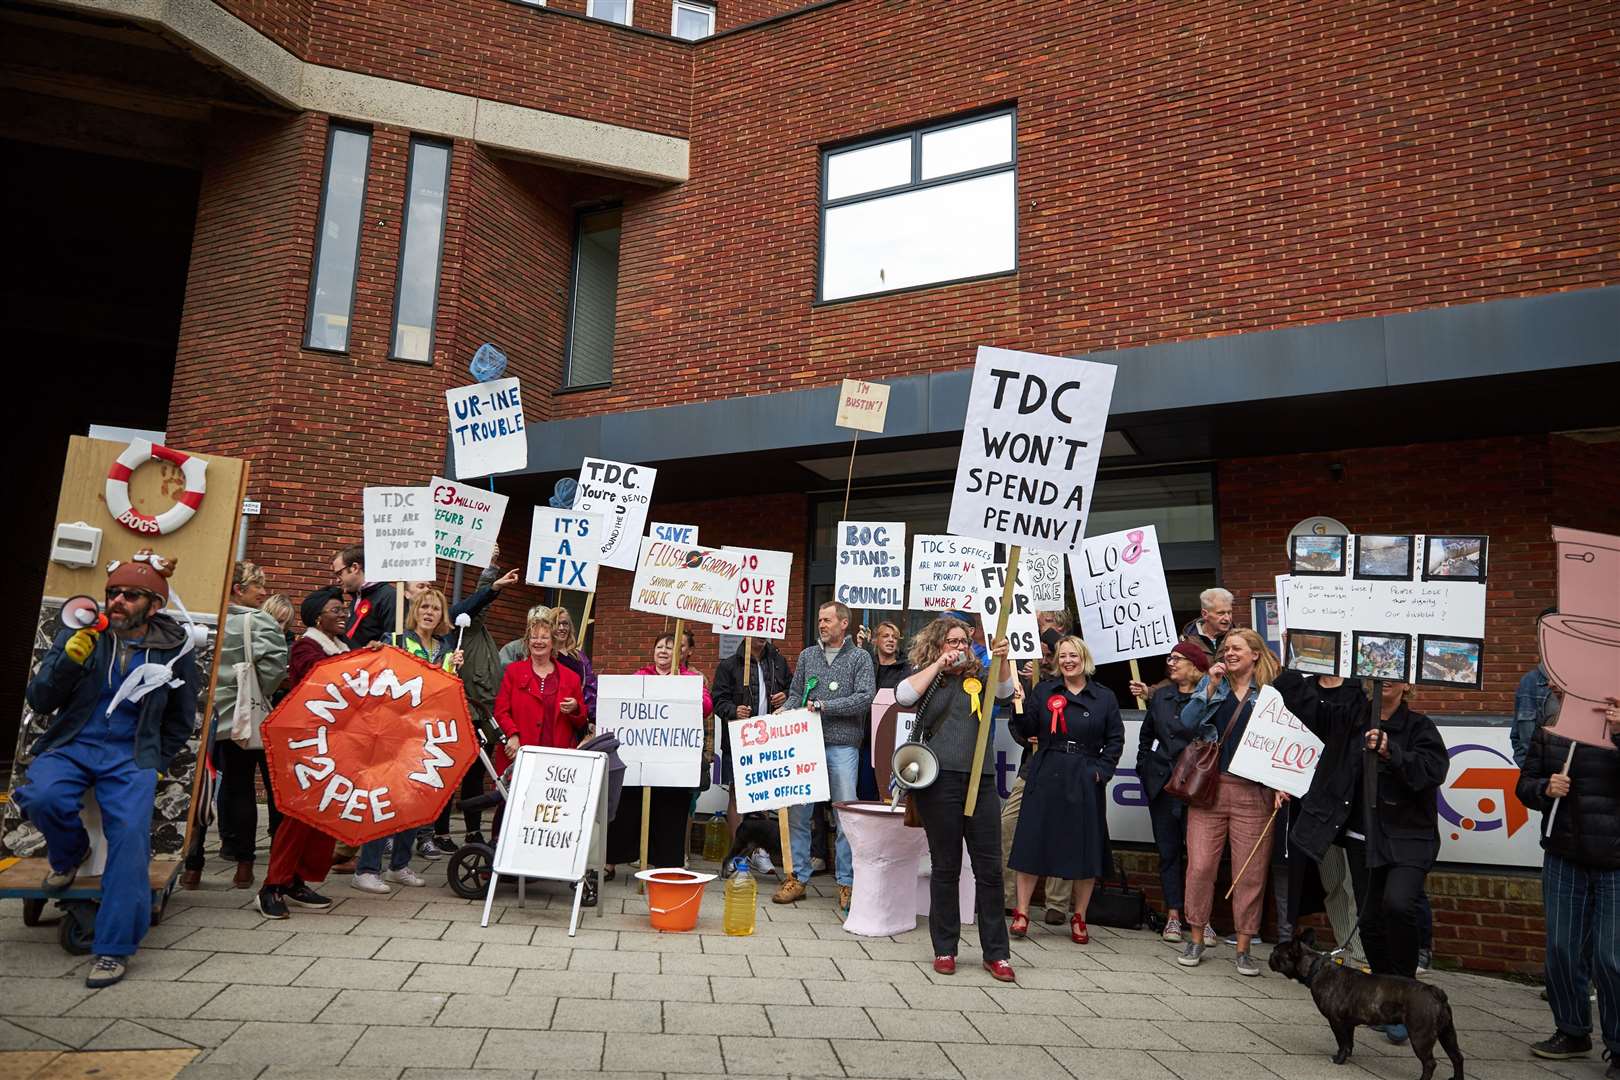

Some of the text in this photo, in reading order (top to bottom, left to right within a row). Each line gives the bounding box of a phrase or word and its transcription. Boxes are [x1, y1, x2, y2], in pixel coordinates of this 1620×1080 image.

[857, 383, 870, 394] I'M
[990, 368, 1081, 424] TDC
[454, 386, 519, 421] UR-INE
[455, 413, 524, 446] TROUBLE
[982, 427, 1088, 471] WON'T
[433, 485, 491, 513] £3 MILLION
[582, 483, 616, 502] You're
[966, 468, 1084, 512] SPEND A
[119, 510, 159, 532] BOGS
[372, 513, 420, 523] WEE ARE
[434, 509, 484, 530] EFURB IS
[554, 517, 589, 537] IT'S
[600, 494, 648, 554] ROUND THE U BEND
[376, 528, 415, 538] HOLDING
[435, 530, 461, 546] OT A
[655, 526, 693, 544] SAVE
[845, 525, 890, 546] BOG
[983, 507, 1082, 550] PENNY!
[390, 540, 427, 550] YOU TO
[557, 539, 572, 556] A
[961, 546, 992, 560] OFFICES
[644, 542, 740, 580] FLUSH GORDON
[840, 550, 896, 566] STAND-
[919, 561, 930, 569] ARE
[538, 556, 588, 587] FIX
[873, 566, 901, 578] ARD
[933, 573, 963, 581] PRIORITY
[677, 580, 688, 589] OF
[740, 577, 775, 595] OUR
[942, 584, 966, 592] SHOULD
[1031, 582, 1061, 601] AKE
[1081, 575, 1141, 607] Little
[638, 588, 735, 618] PUBLIC CONVENIENCES
[837, 584, 902, 605] COUNCIL
[924, 594, 972, 609] NUMBER 2
[737, 598, 773, 614] WEE
[722, 615, 785, 633] OBBIES
[1115, 615, 1170, 653] LATE!
[619, 702, 669, 720] PUBLIC
[601, 727, 702, 748] CONVENIENCE
[740, 719, 809, 747] £3 MILLION
[287, 668, 458, 823] WE WANT 2 PEE
[740, 747, 796, 766] ON PUBLIC
[545, 765, 577, 783] SIGN
[745, 762, 817, 786] SERVICES NOT
[545, 787, 567, 803] OUR
[748, 784, 811, 803] YOUR OFFICES
[523, 827, 573, 849] TITION
